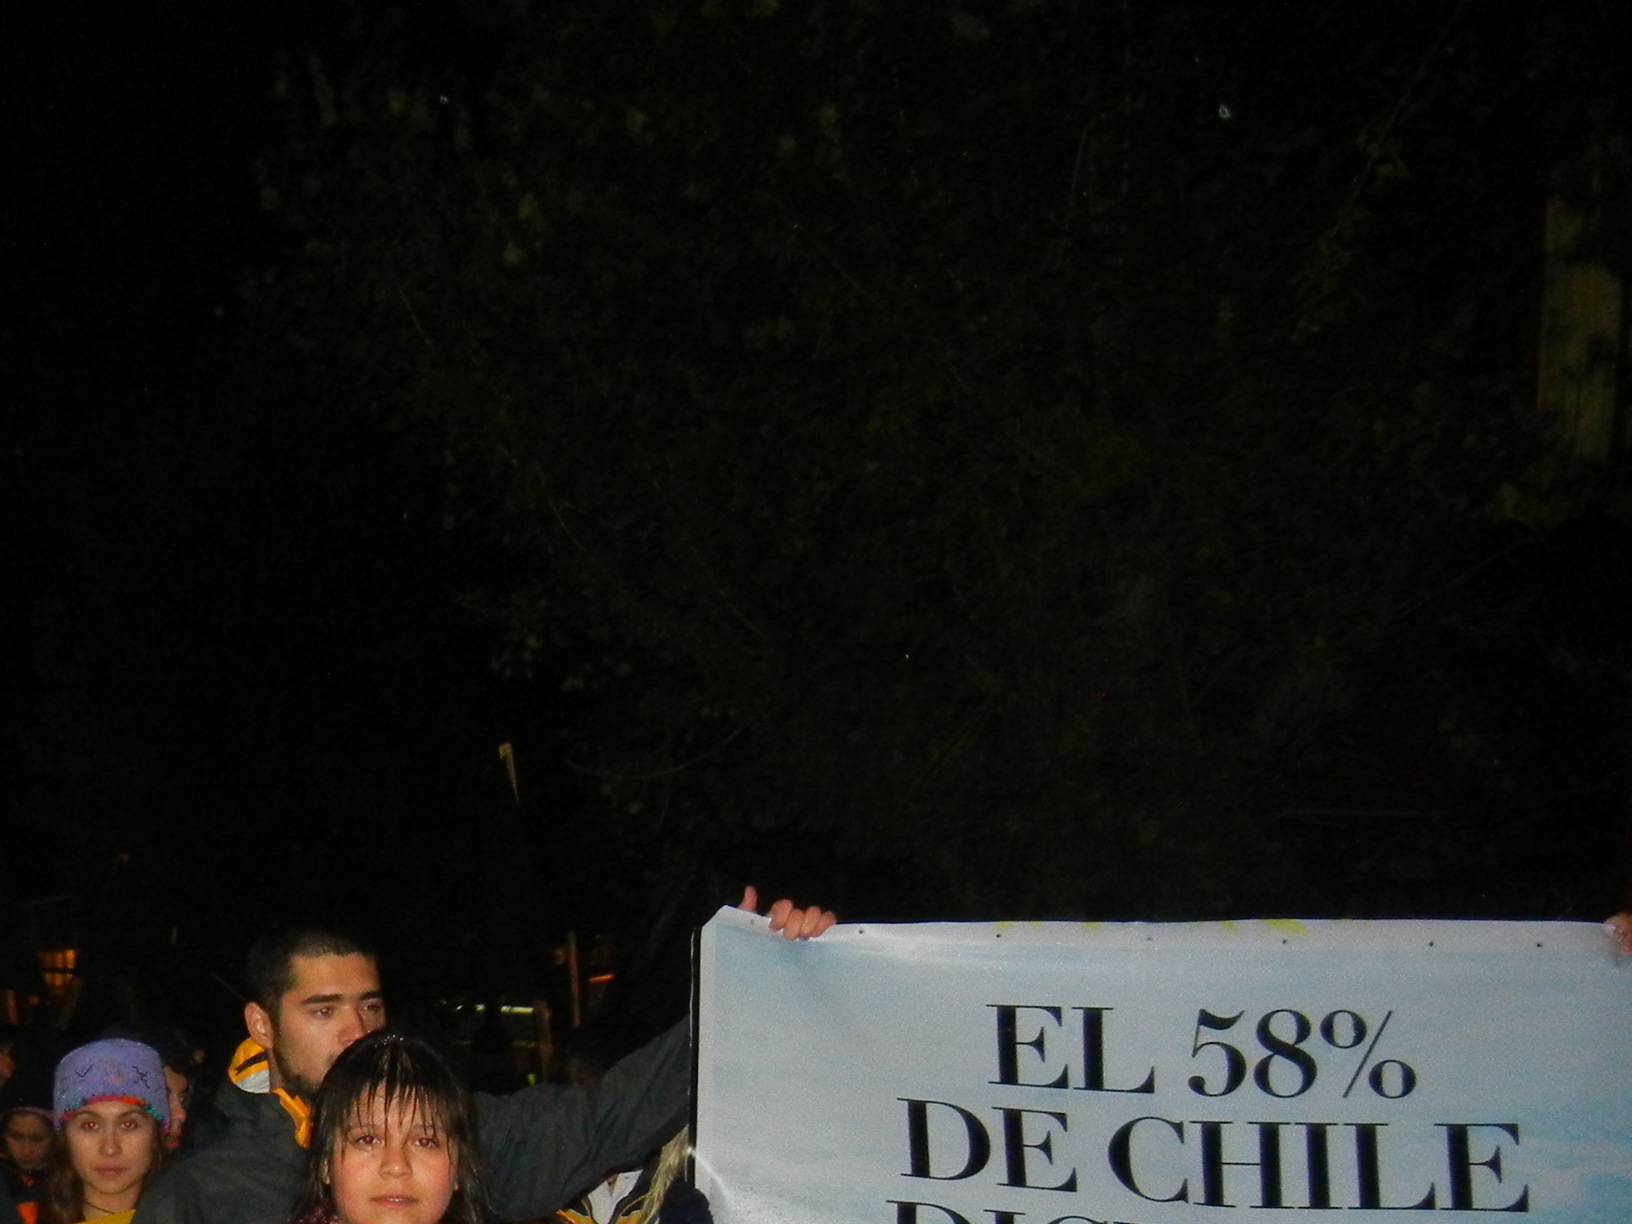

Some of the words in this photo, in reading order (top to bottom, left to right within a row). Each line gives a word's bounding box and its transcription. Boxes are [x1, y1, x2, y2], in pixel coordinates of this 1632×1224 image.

[985, 1003, 1156, 1095] EL
[1186, 1008, 1418, 1101] 58%
[896, 1097, 1079, 1193] DE
[1106, 1115, 1530, 1213] CHILE
